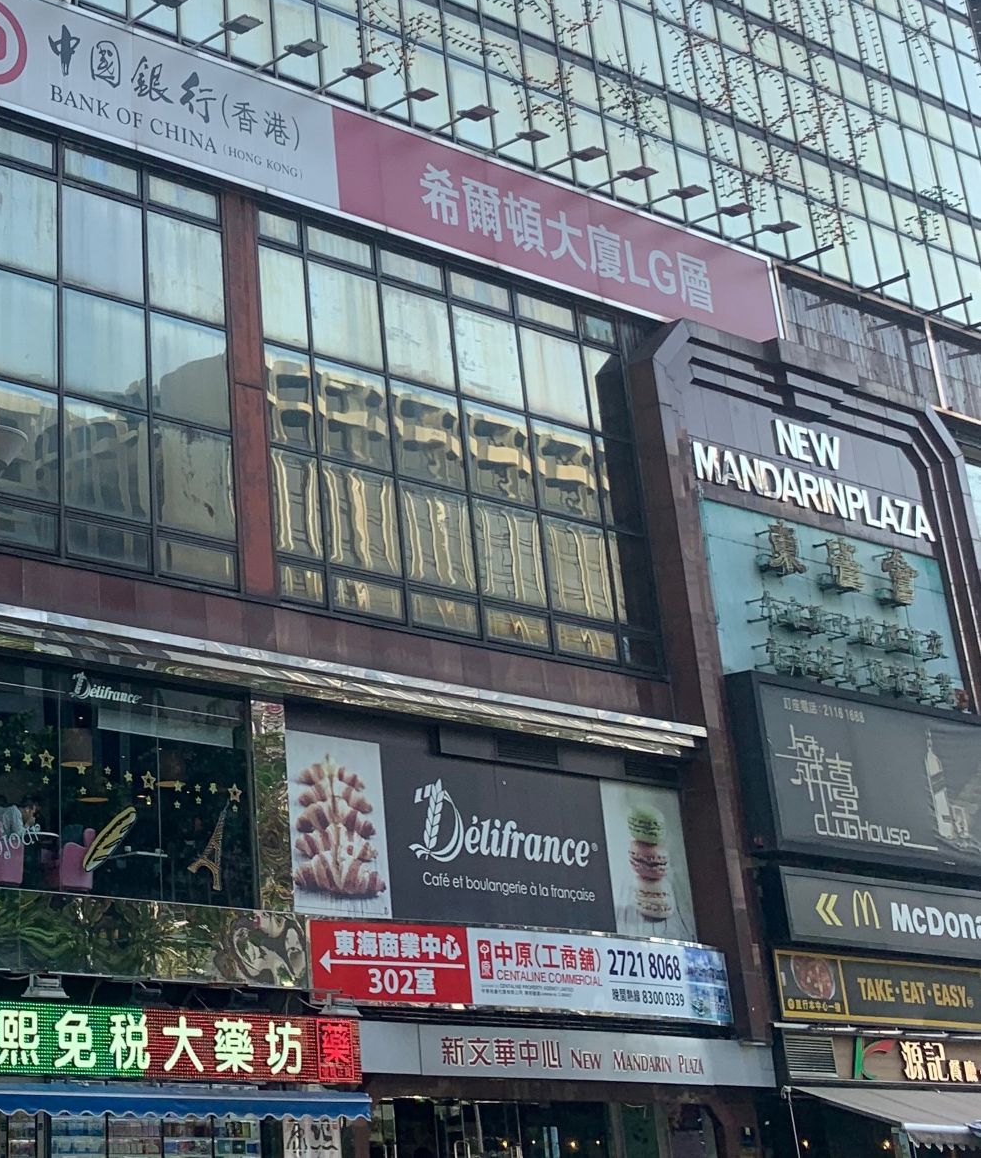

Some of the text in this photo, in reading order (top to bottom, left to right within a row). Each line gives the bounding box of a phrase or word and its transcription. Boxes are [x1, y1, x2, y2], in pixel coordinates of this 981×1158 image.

[50, 84, 110, 119] BANK
[116, 107, 143, 129] OF
[150, 118, 218, 154] CHINA
[775, 419, 840, 470] NEW
[408, 778, 591, 868] Délifrance
[422, 871, 596, 902] Café et boulangerie à la française
[333, 930, 463, 960] 東海商業中心
[496, 969, 603, 987] CENTALINE COMMERCIAL
[607, 949, 682, 981] 2721 8068
[368, 968, 437, 995] 302室
[643, 989, 664, 1005] 8300
[665, 992, 685, 1007] 0339
[441, 1036, 563, 1069] 新文華中心
